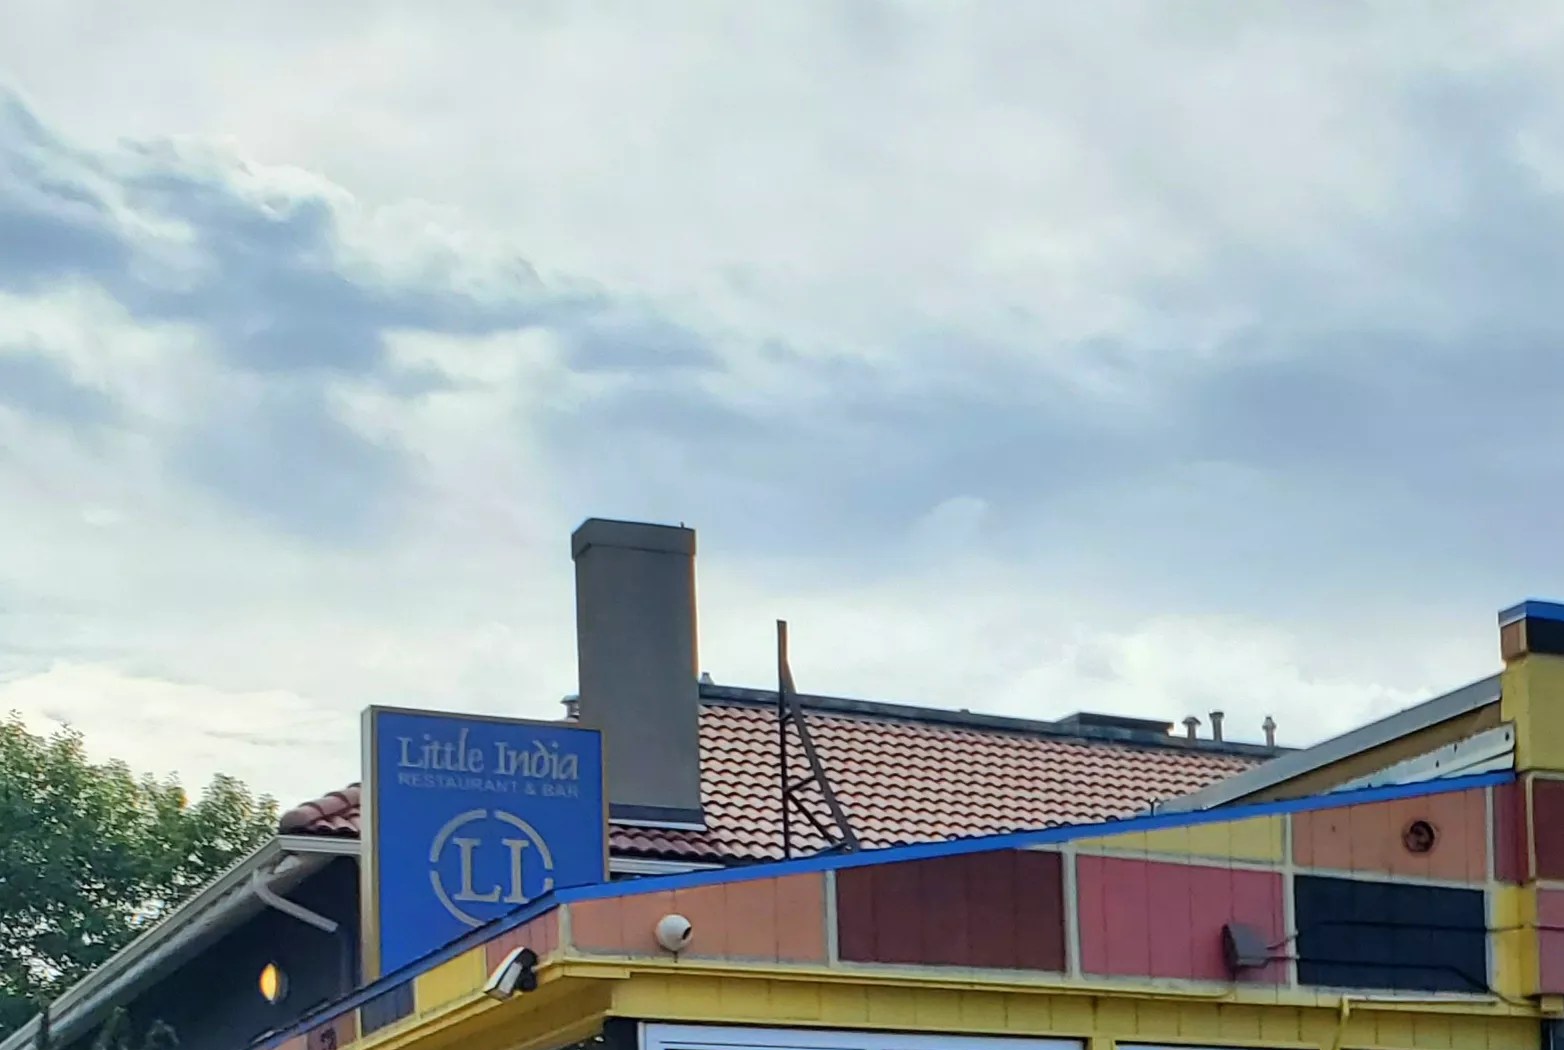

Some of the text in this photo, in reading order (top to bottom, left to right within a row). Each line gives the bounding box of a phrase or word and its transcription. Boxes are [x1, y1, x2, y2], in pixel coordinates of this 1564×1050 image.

[396, 728, 579, 780] Little India
[398, 772, 579, 799] RESTAURANT & BAR
[453, 837, 529, 904] LI
